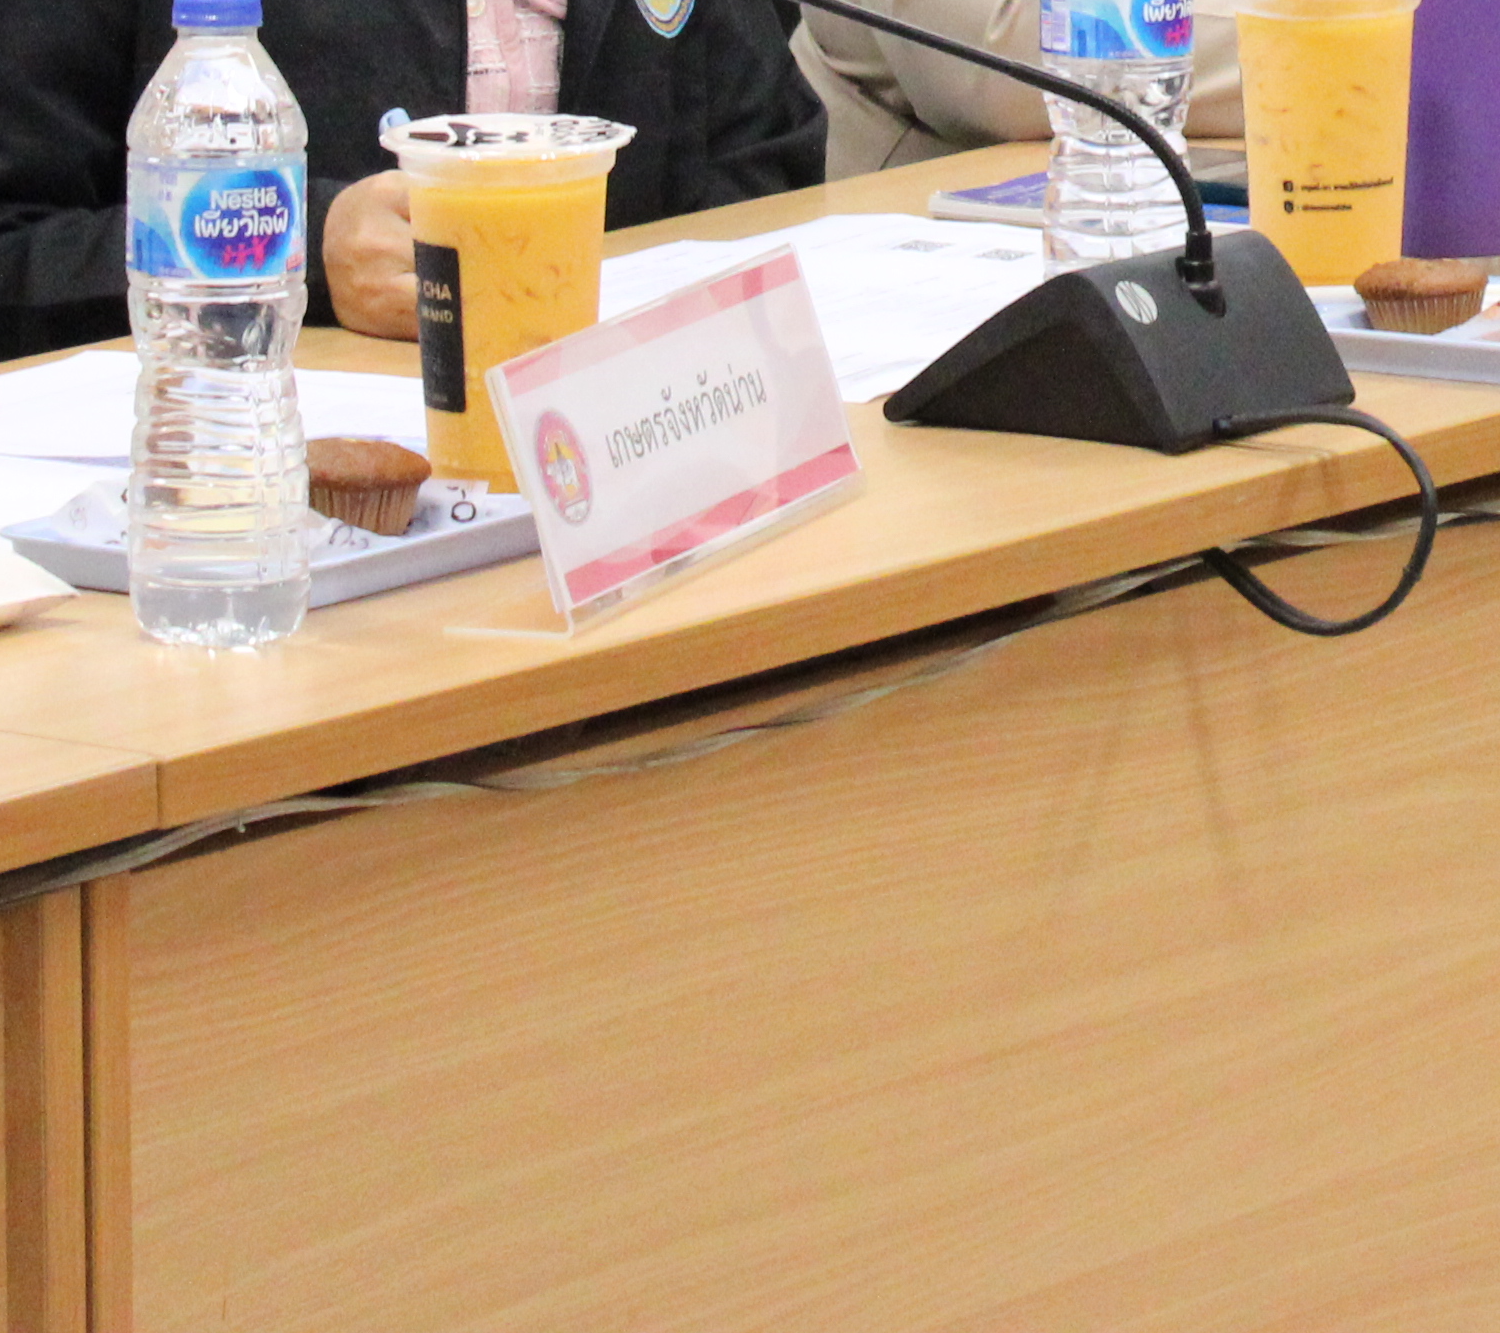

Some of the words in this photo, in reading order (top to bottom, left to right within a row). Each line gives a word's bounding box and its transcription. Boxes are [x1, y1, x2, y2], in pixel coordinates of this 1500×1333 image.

[605, 363, 768, 468] เกษตรจังหวัดน่าน
